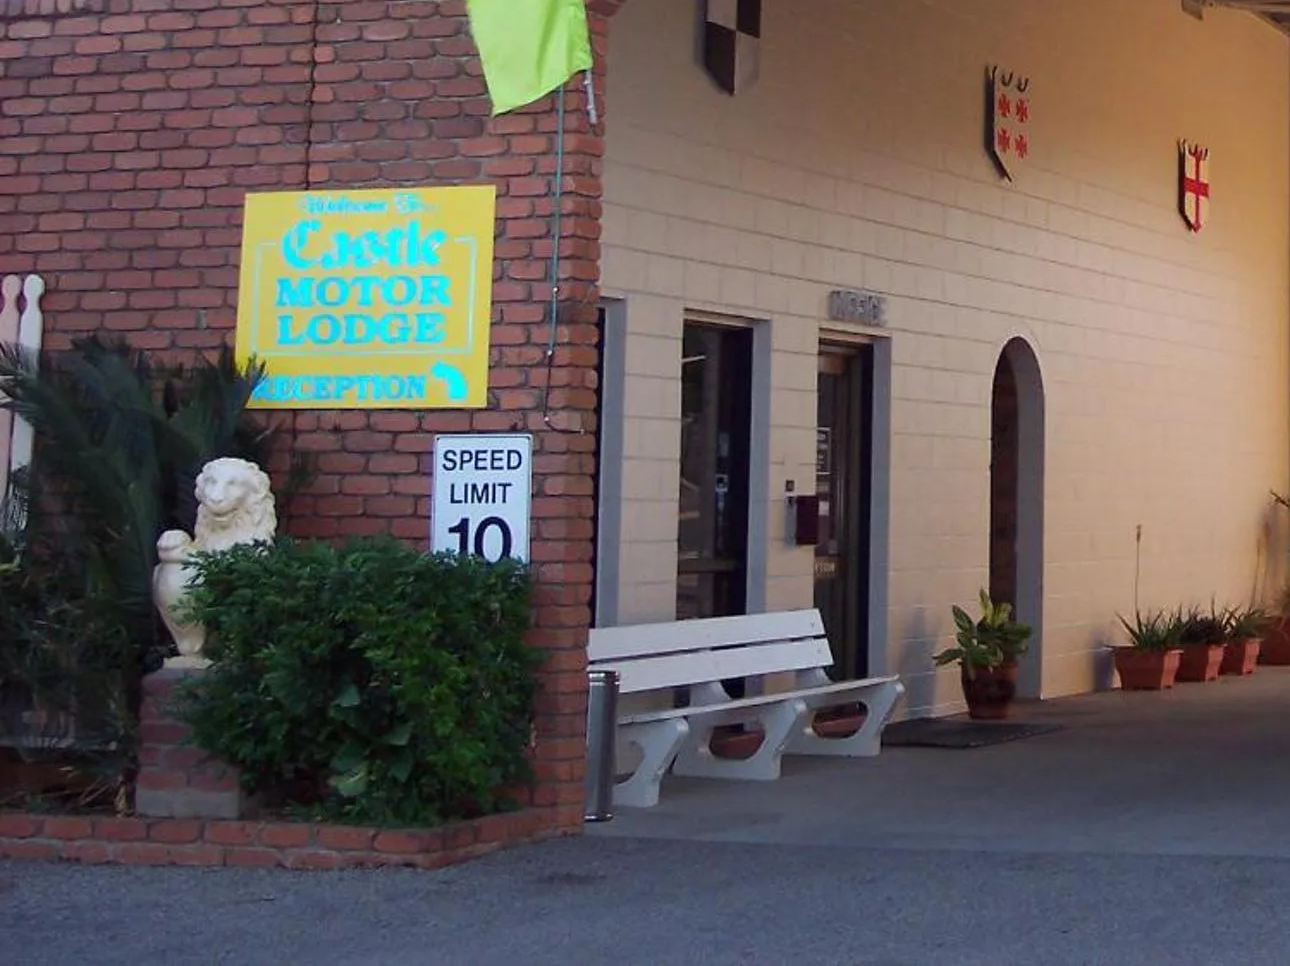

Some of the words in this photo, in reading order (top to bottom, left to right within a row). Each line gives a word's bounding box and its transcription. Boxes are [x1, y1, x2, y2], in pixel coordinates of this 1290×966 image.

[282, 218, 448, 270] Castle
[275, 274, 452, 307] MOTOR
[276, 313, 447, 346] LODGE
[442, 449, 522, 471] SPEED
[449, 482, 513, 504] LIMIT
[448, 516, 512, 564] 10
